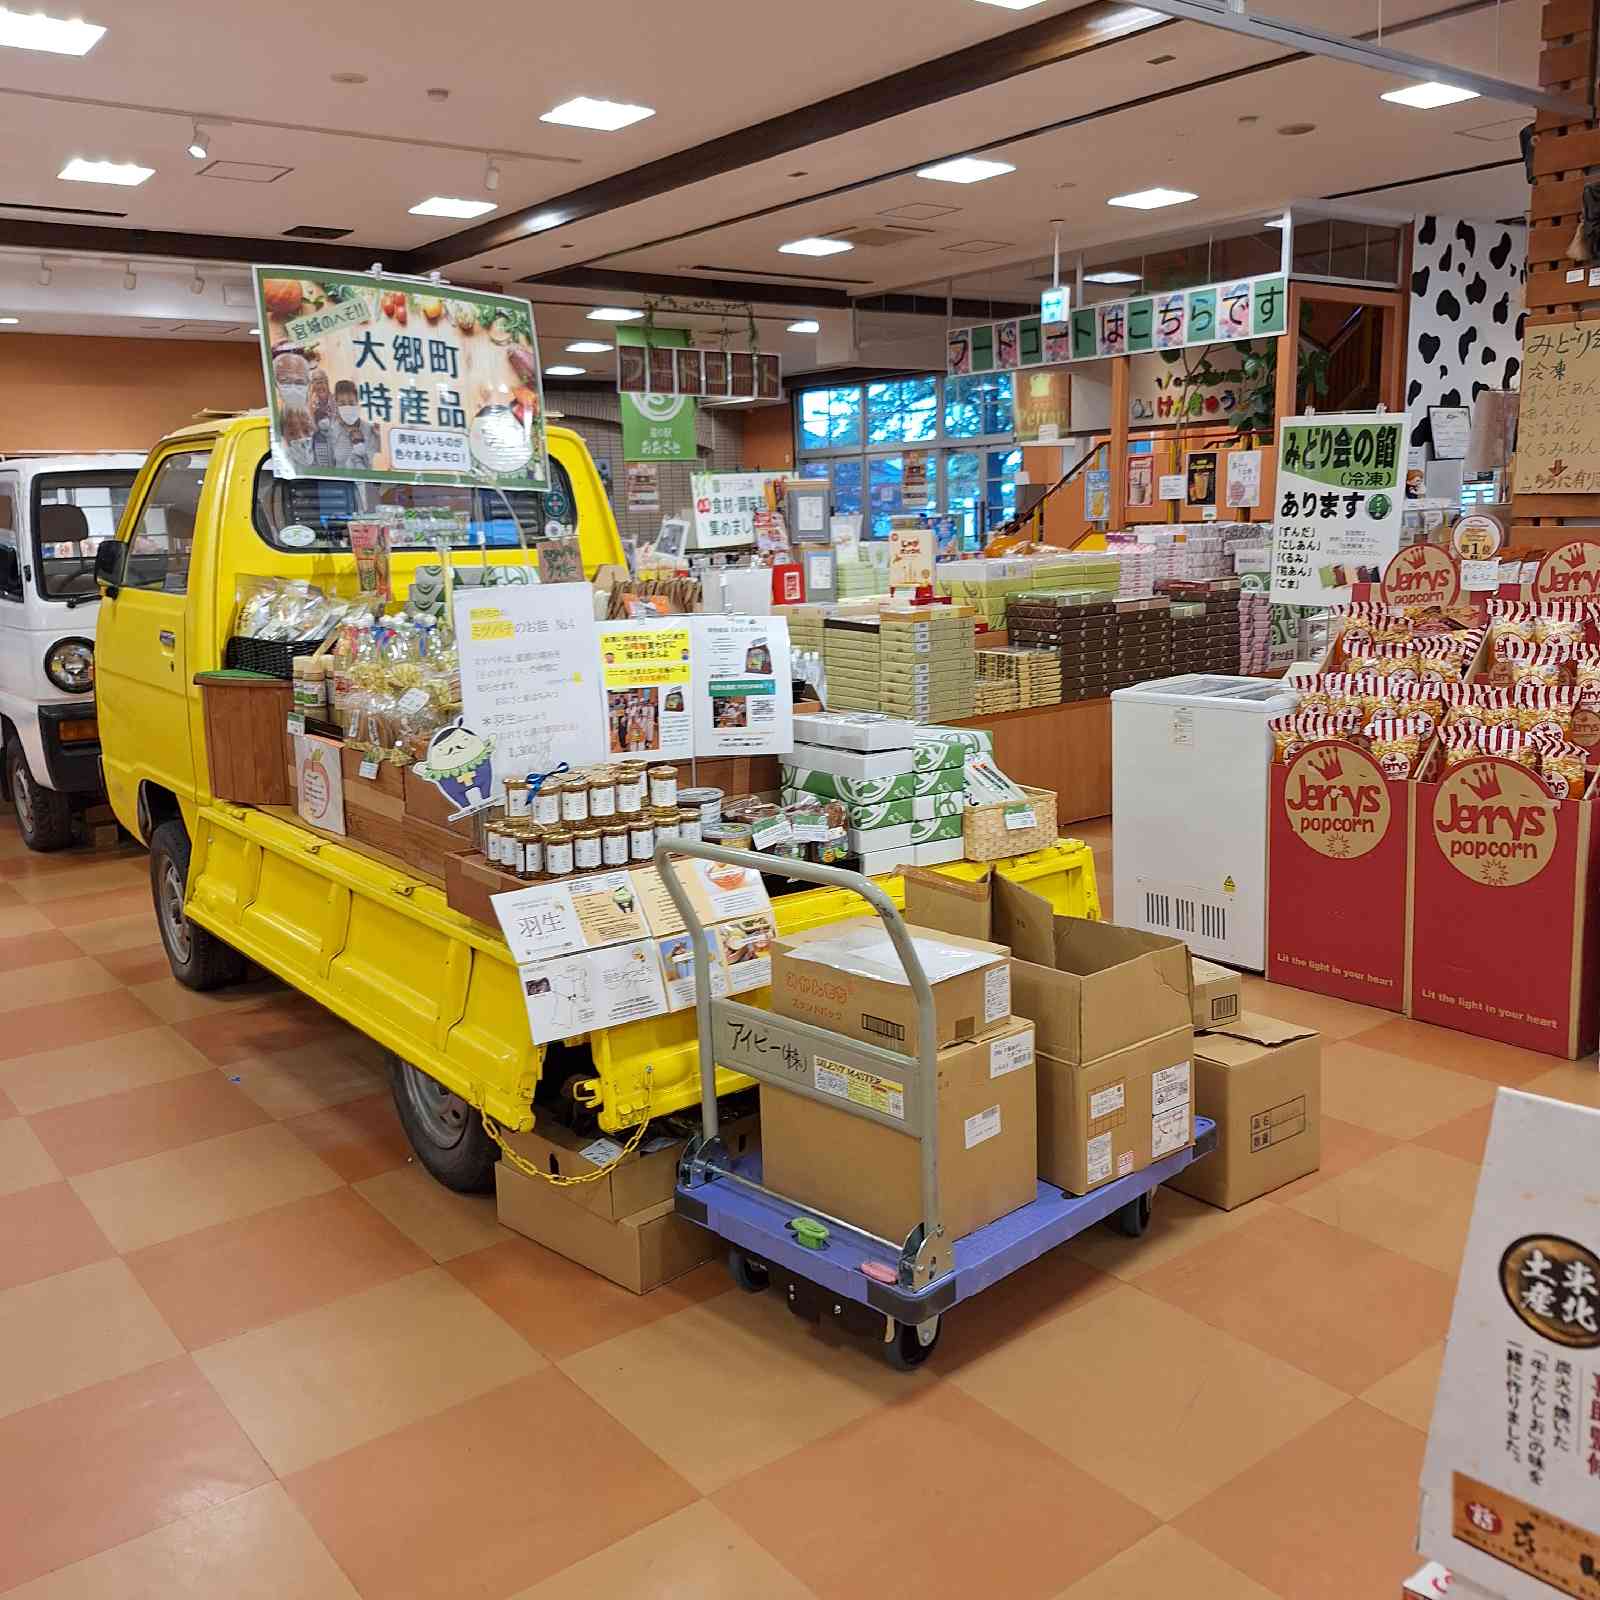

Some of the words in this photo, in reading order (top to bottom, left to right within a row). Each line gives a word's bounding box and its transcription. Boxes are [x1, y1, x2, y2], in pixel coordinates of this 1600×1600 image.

[352, 331, 459, 378] 大郷町
[359, 382, 466, 428] 特産品
[1280, 491, 1365, 519] あります
[1287, 775, 1381, 817] Jerrys
[1301, 815, 1375, 834] popcorn
[1436, 793, 1546, 841] Jerrys
[1450, 838, 1538, 859] popcorn
[1277, 952, 1290, 963] Lit
[1292, 957, 1307, 967] the
[1309, 959, 1330, 974] light
[1332, 966, 1341, 975] in
[1343, 970, 1365, 982] your
[1367, 973, 1393, 987] heart
[1421, 988, 1435, 1000] Lit
[1438, 992, 1455, 1004] the
[1458, 996, 1483, 1012] light
[1485, 1003, 1496, 1013] in
[1498, 1007, 1524, 1021] your
